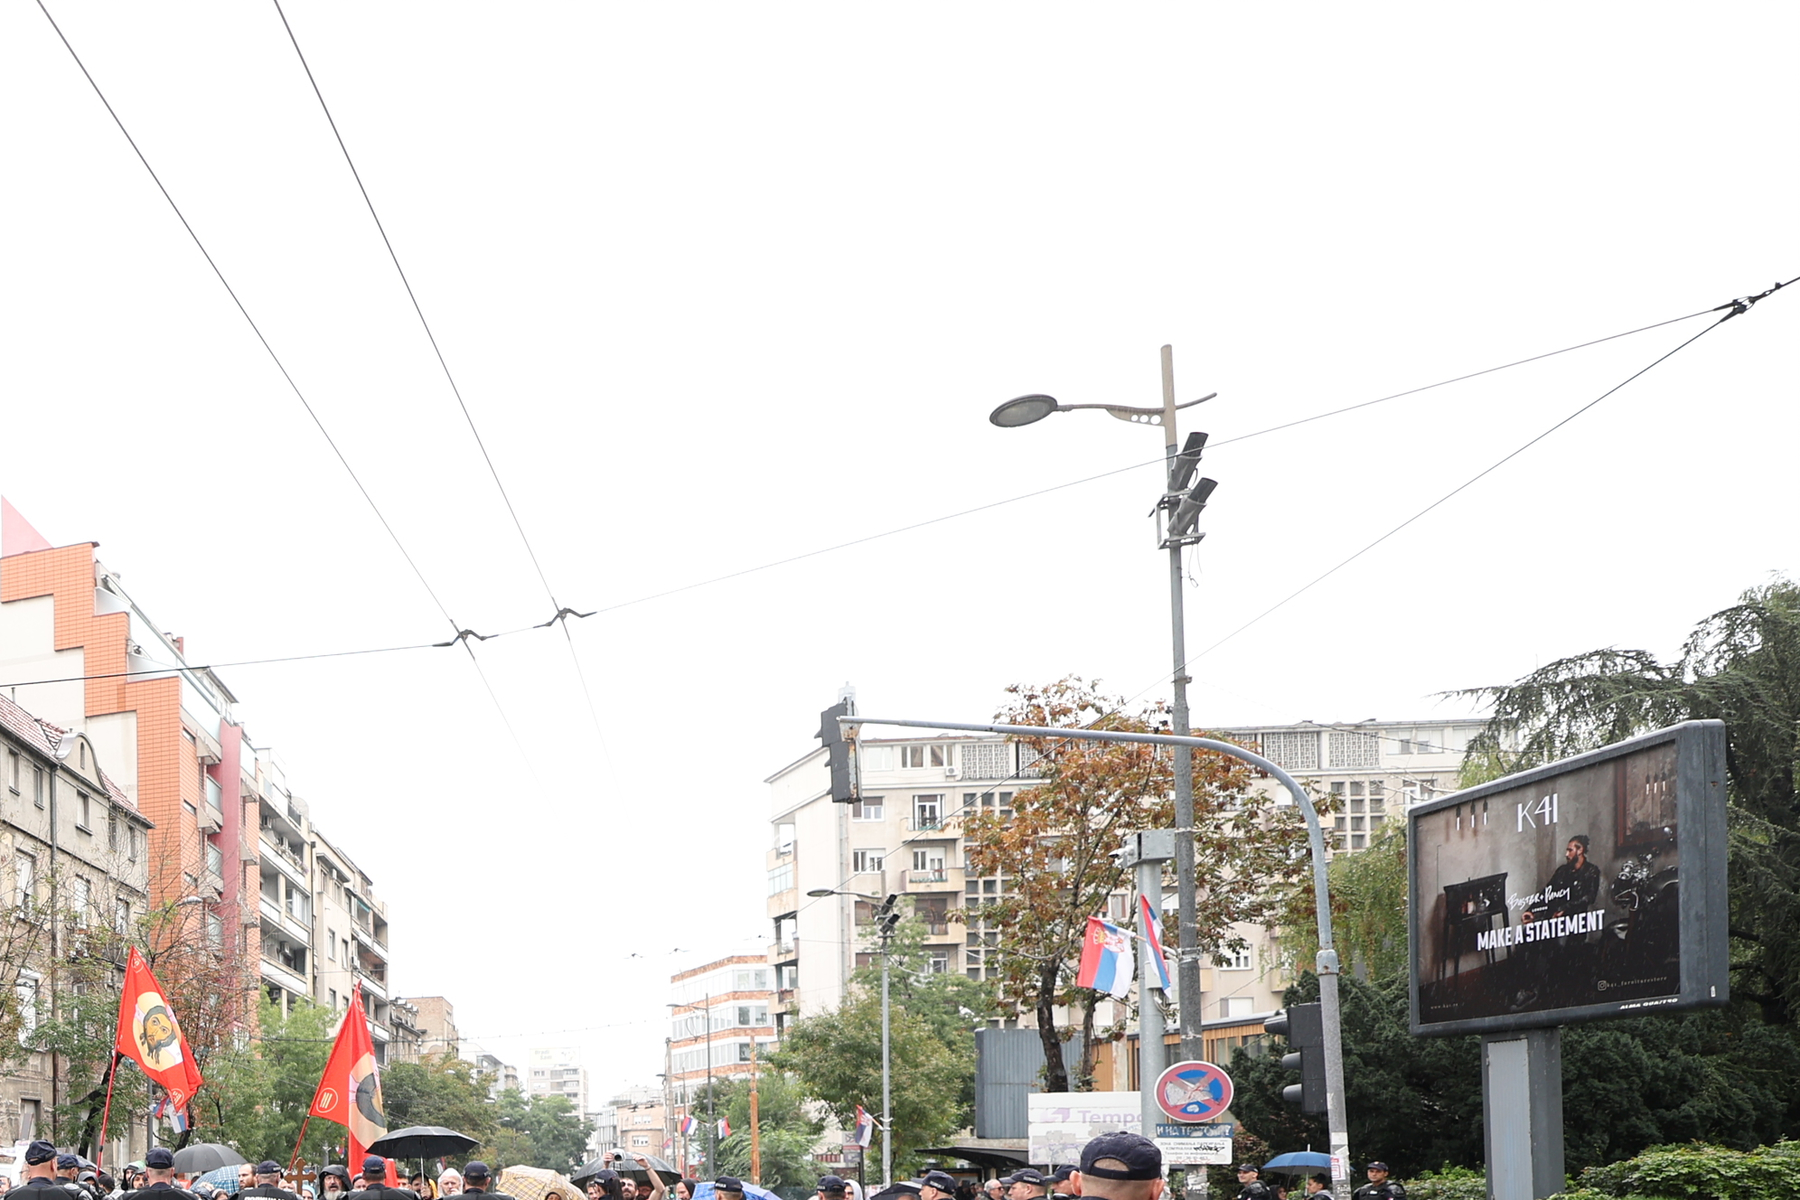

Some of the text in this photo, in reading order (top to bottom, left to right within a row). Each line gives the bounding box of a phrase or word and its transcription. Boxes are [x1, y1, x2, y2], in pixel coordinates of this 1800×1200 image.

[1477, 909, 1605, 951] MAKE A STATEMENT
[1165, 1126, 1179, 1136] НА
